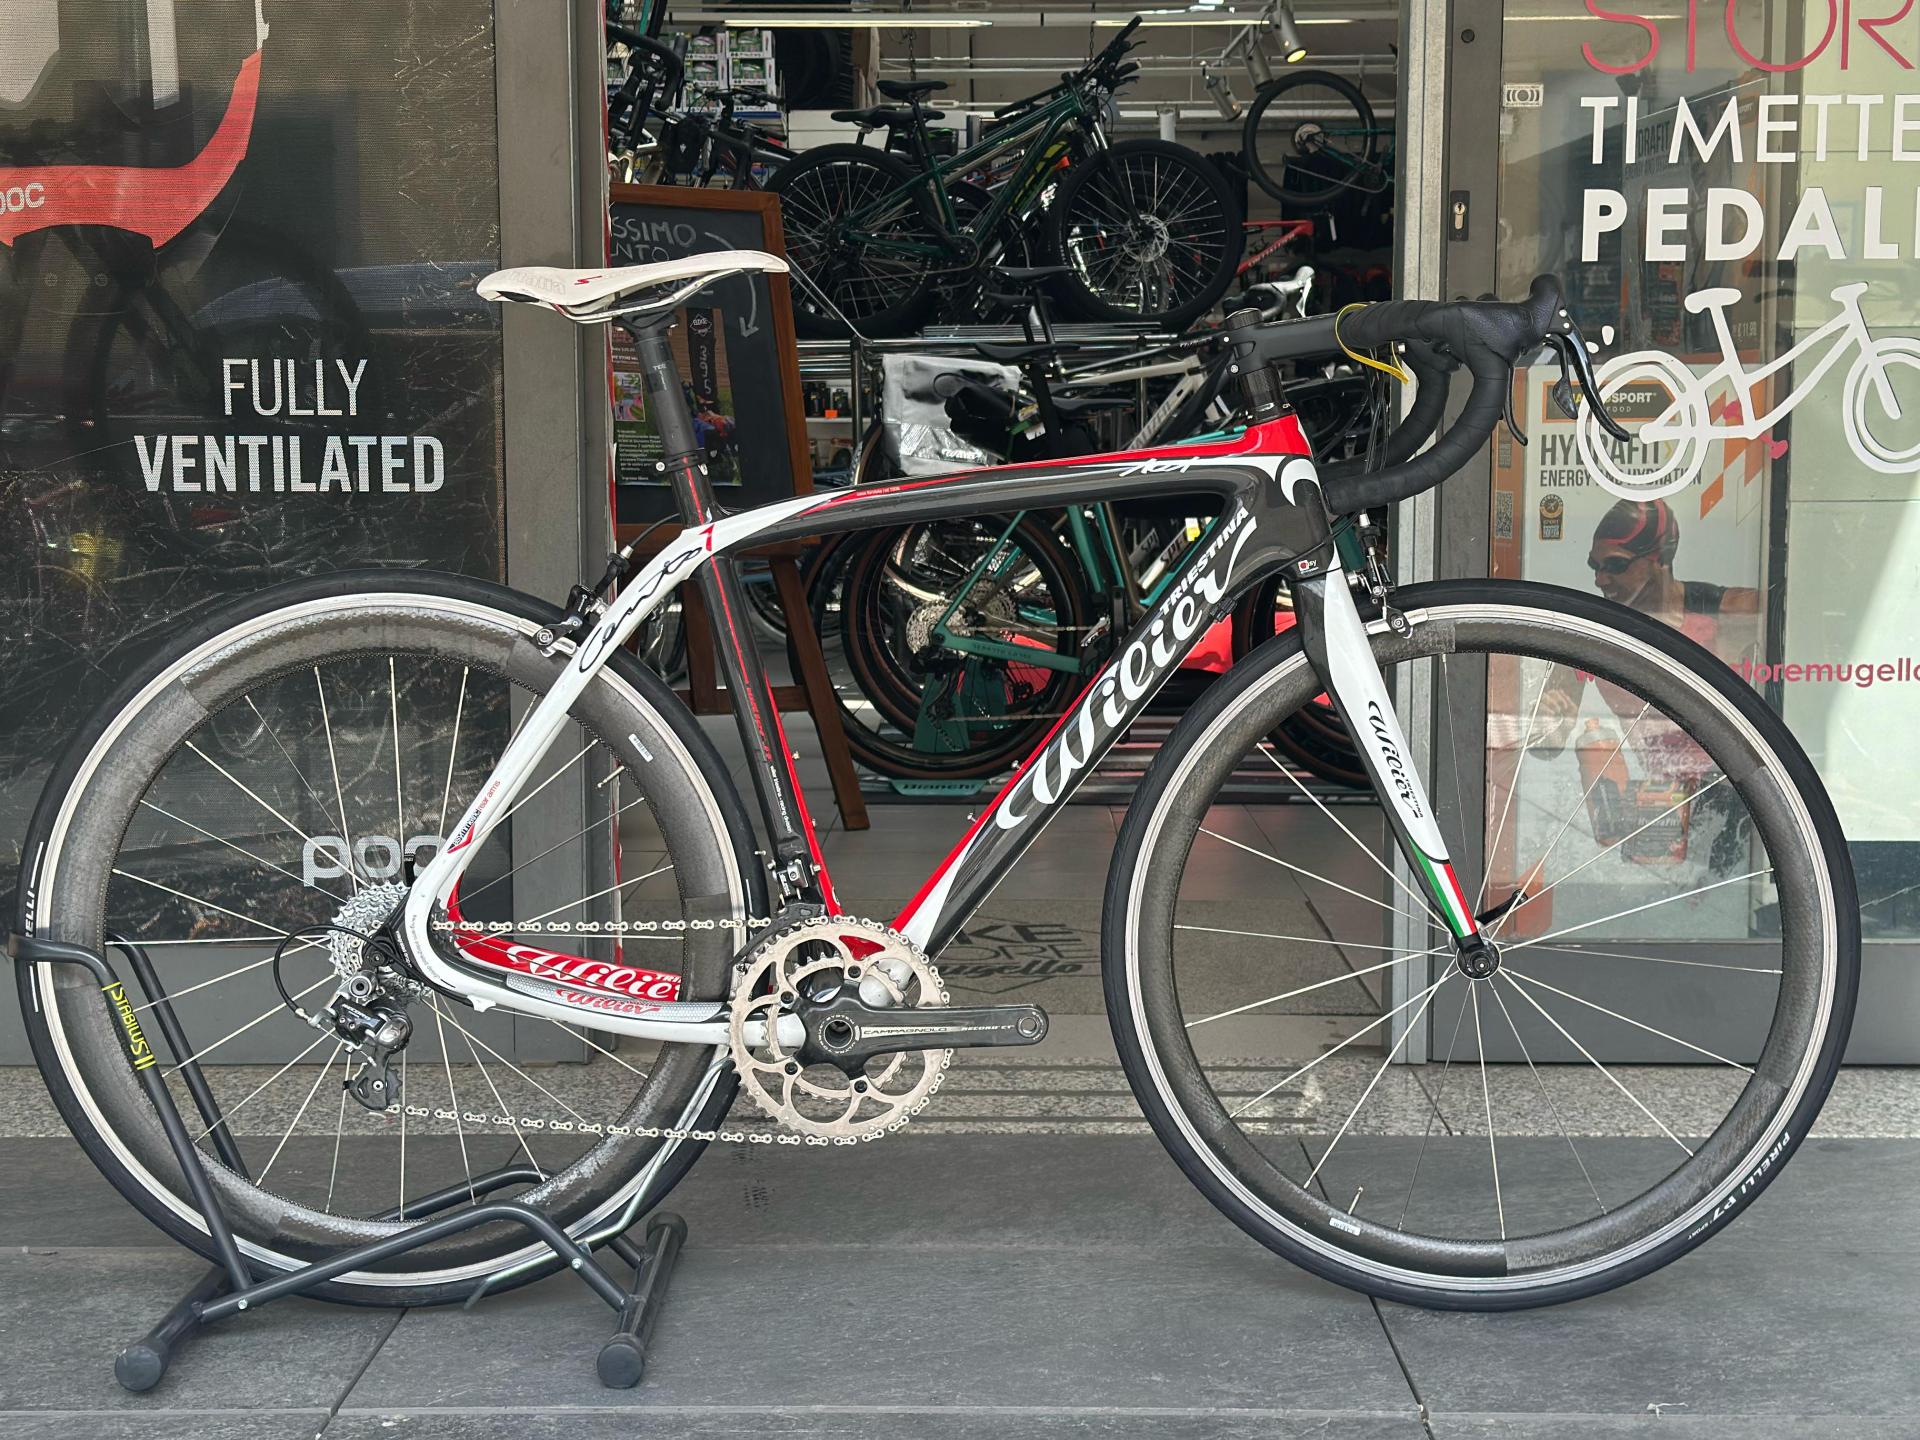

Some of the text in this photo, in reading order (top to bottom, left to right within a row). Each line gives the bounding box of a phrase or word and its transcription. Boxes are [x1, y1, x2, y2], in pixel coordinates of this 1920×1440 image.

[1580, 95, 1920, 164] TI METTE
[1581, 187, 1920, 261] PEDAL
[222, 358, 368, 416] FULLY
[134, 435, 445, 492] VENTILATED
[1540, 469, 1592, 488] ENERGY
[1160, 507, 1249, 616] TRIESTINA
[995, 516, 1257, 830] Wilier
[1368, 700, 1419, 819] Wilier
[1404, 777, 1424, 818] TRIESTINA
[506, 945, 682, 1000] Wilie
[937, 959, 1083, 979] ugello
[555, 988, 662, 1015] Wilier
[863, 1027, 948, 1035] CAMPAGNOLO
[1741, 1131, 1791, 1194] PIRELLI
[1713, 1195, 1737, 1221] P7
